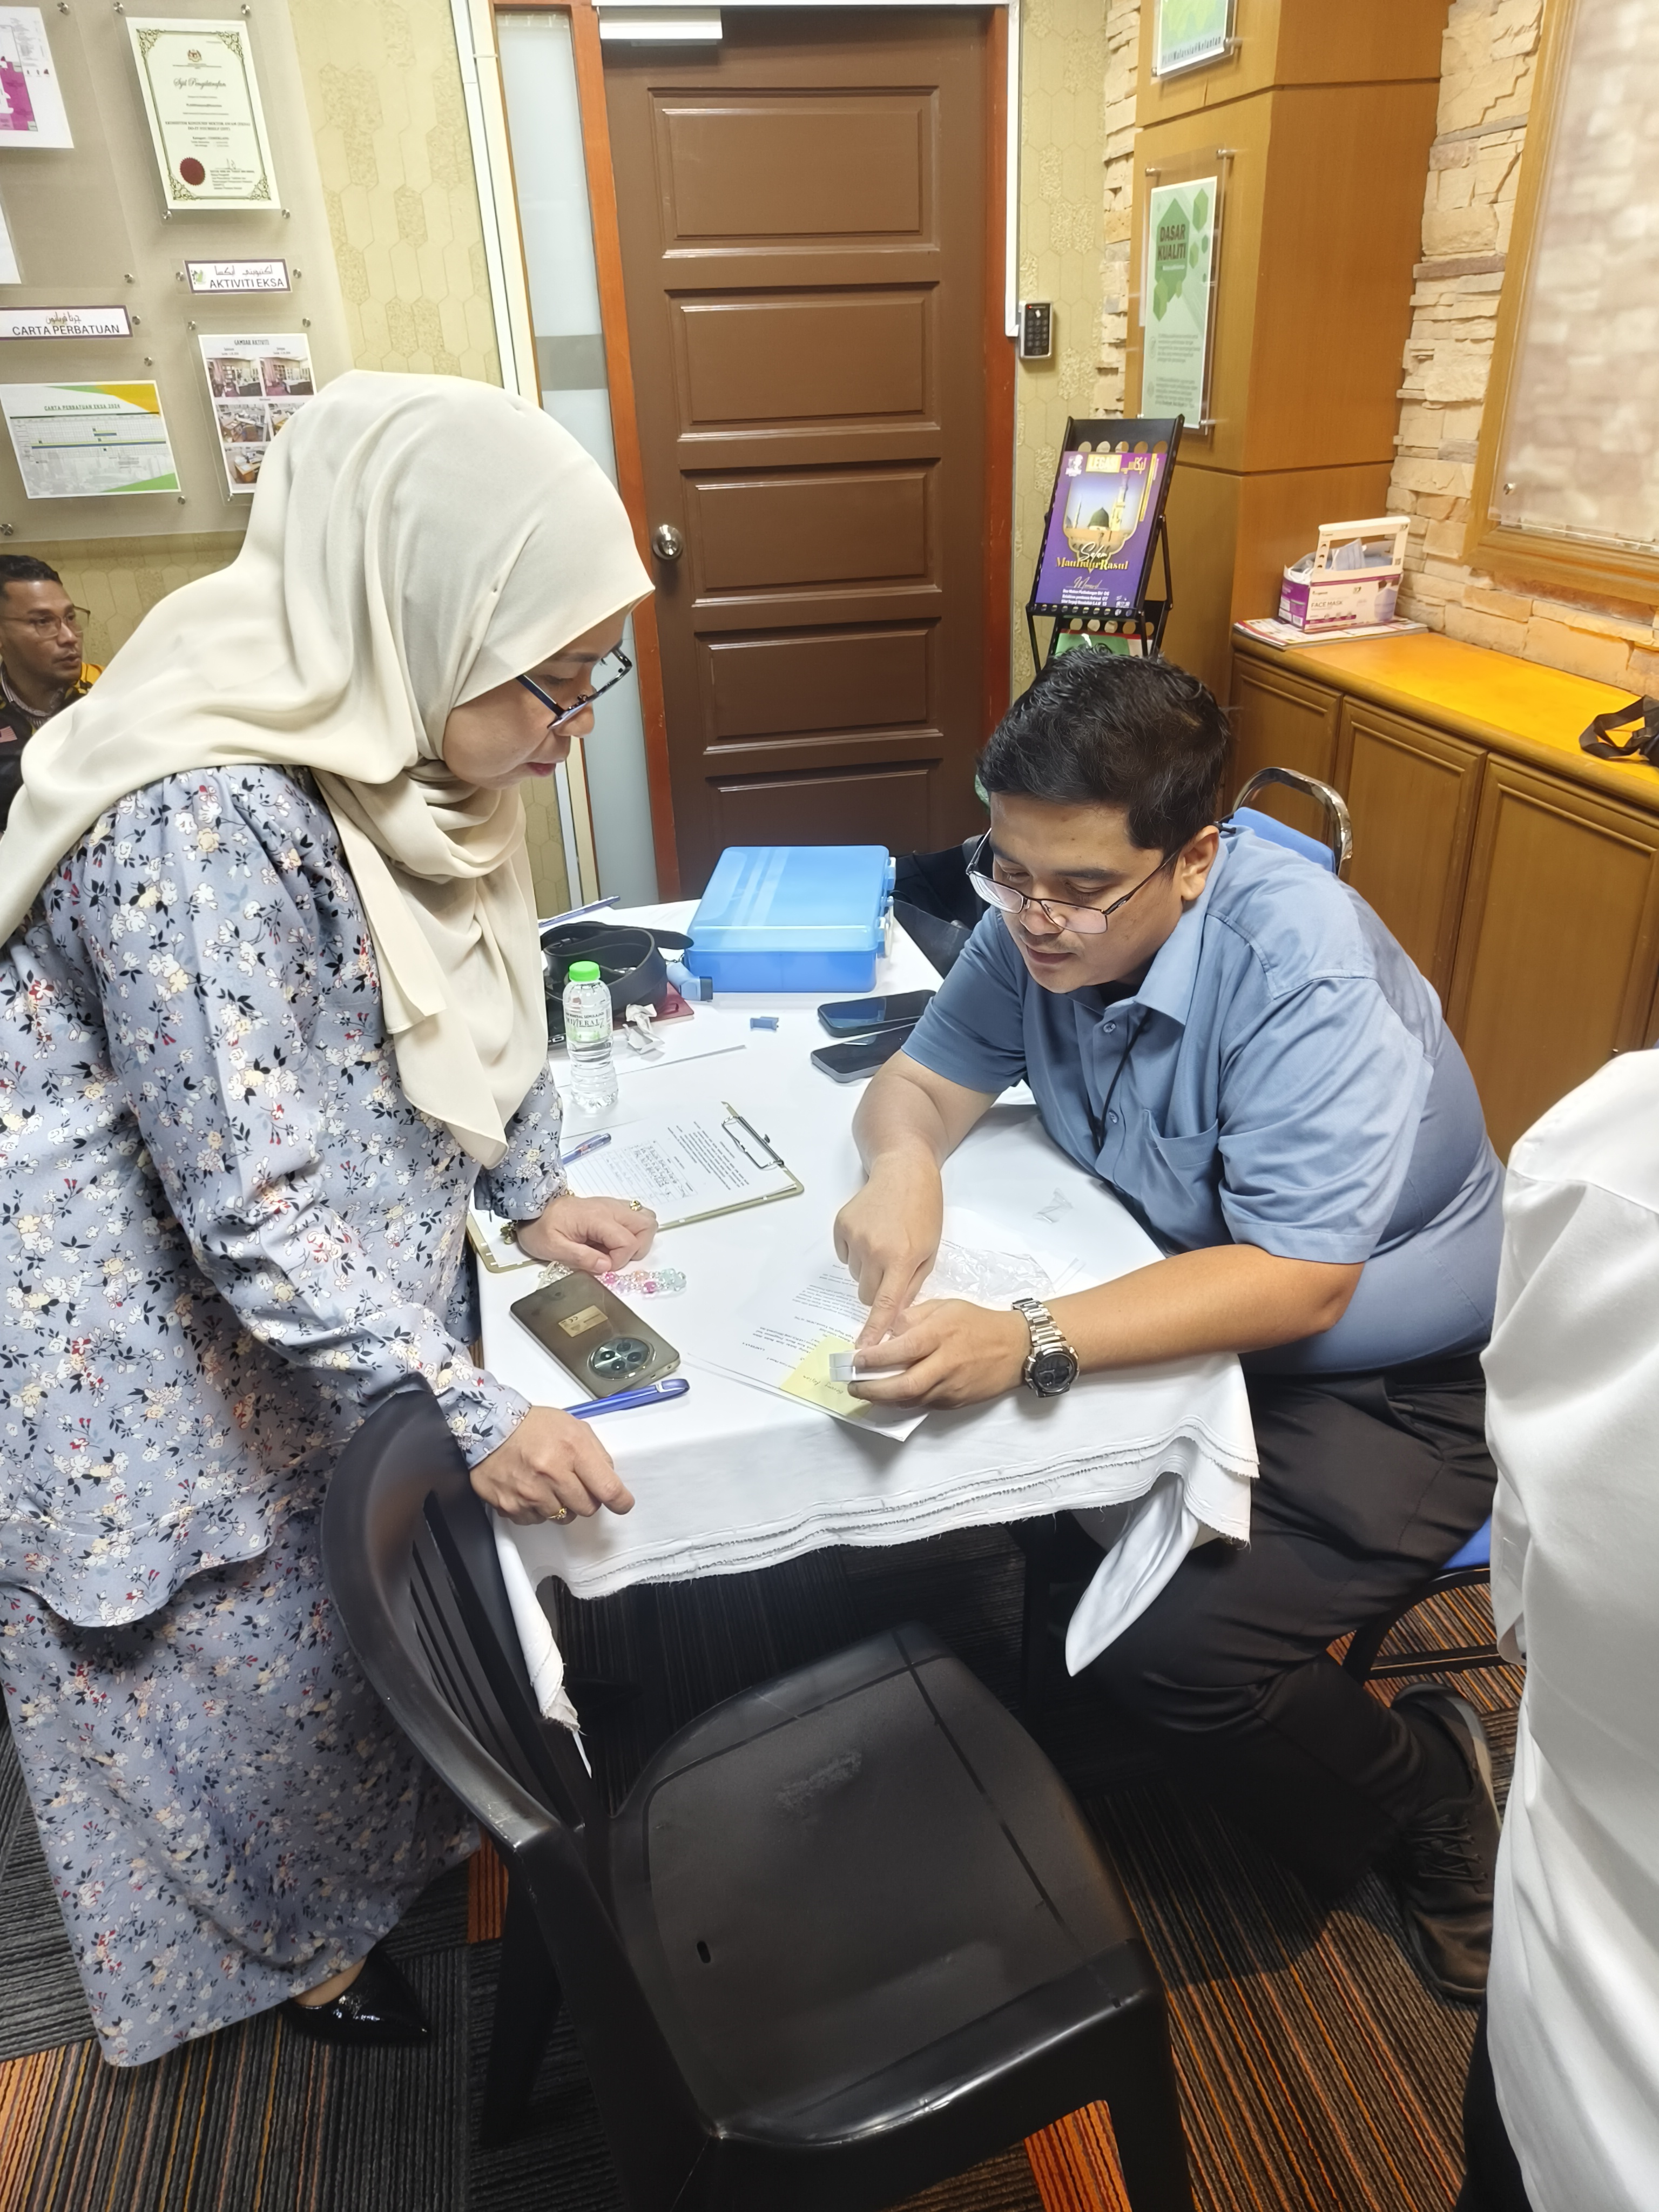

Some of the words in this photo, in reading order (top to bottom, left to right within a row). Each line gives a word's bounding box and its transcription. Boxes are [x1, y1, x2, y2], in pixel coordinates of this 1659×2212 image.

[1160, 224, 1185, 242] DASAR
[1157, 243, 1186, 261] KUALITI
[210, 279, 254, 288] AKTIVITI
[257, 278, 284, 287] EKSA
[12, 326, 51, 336] CARTA
[53, 325, 120, 335] PERBATUAN
